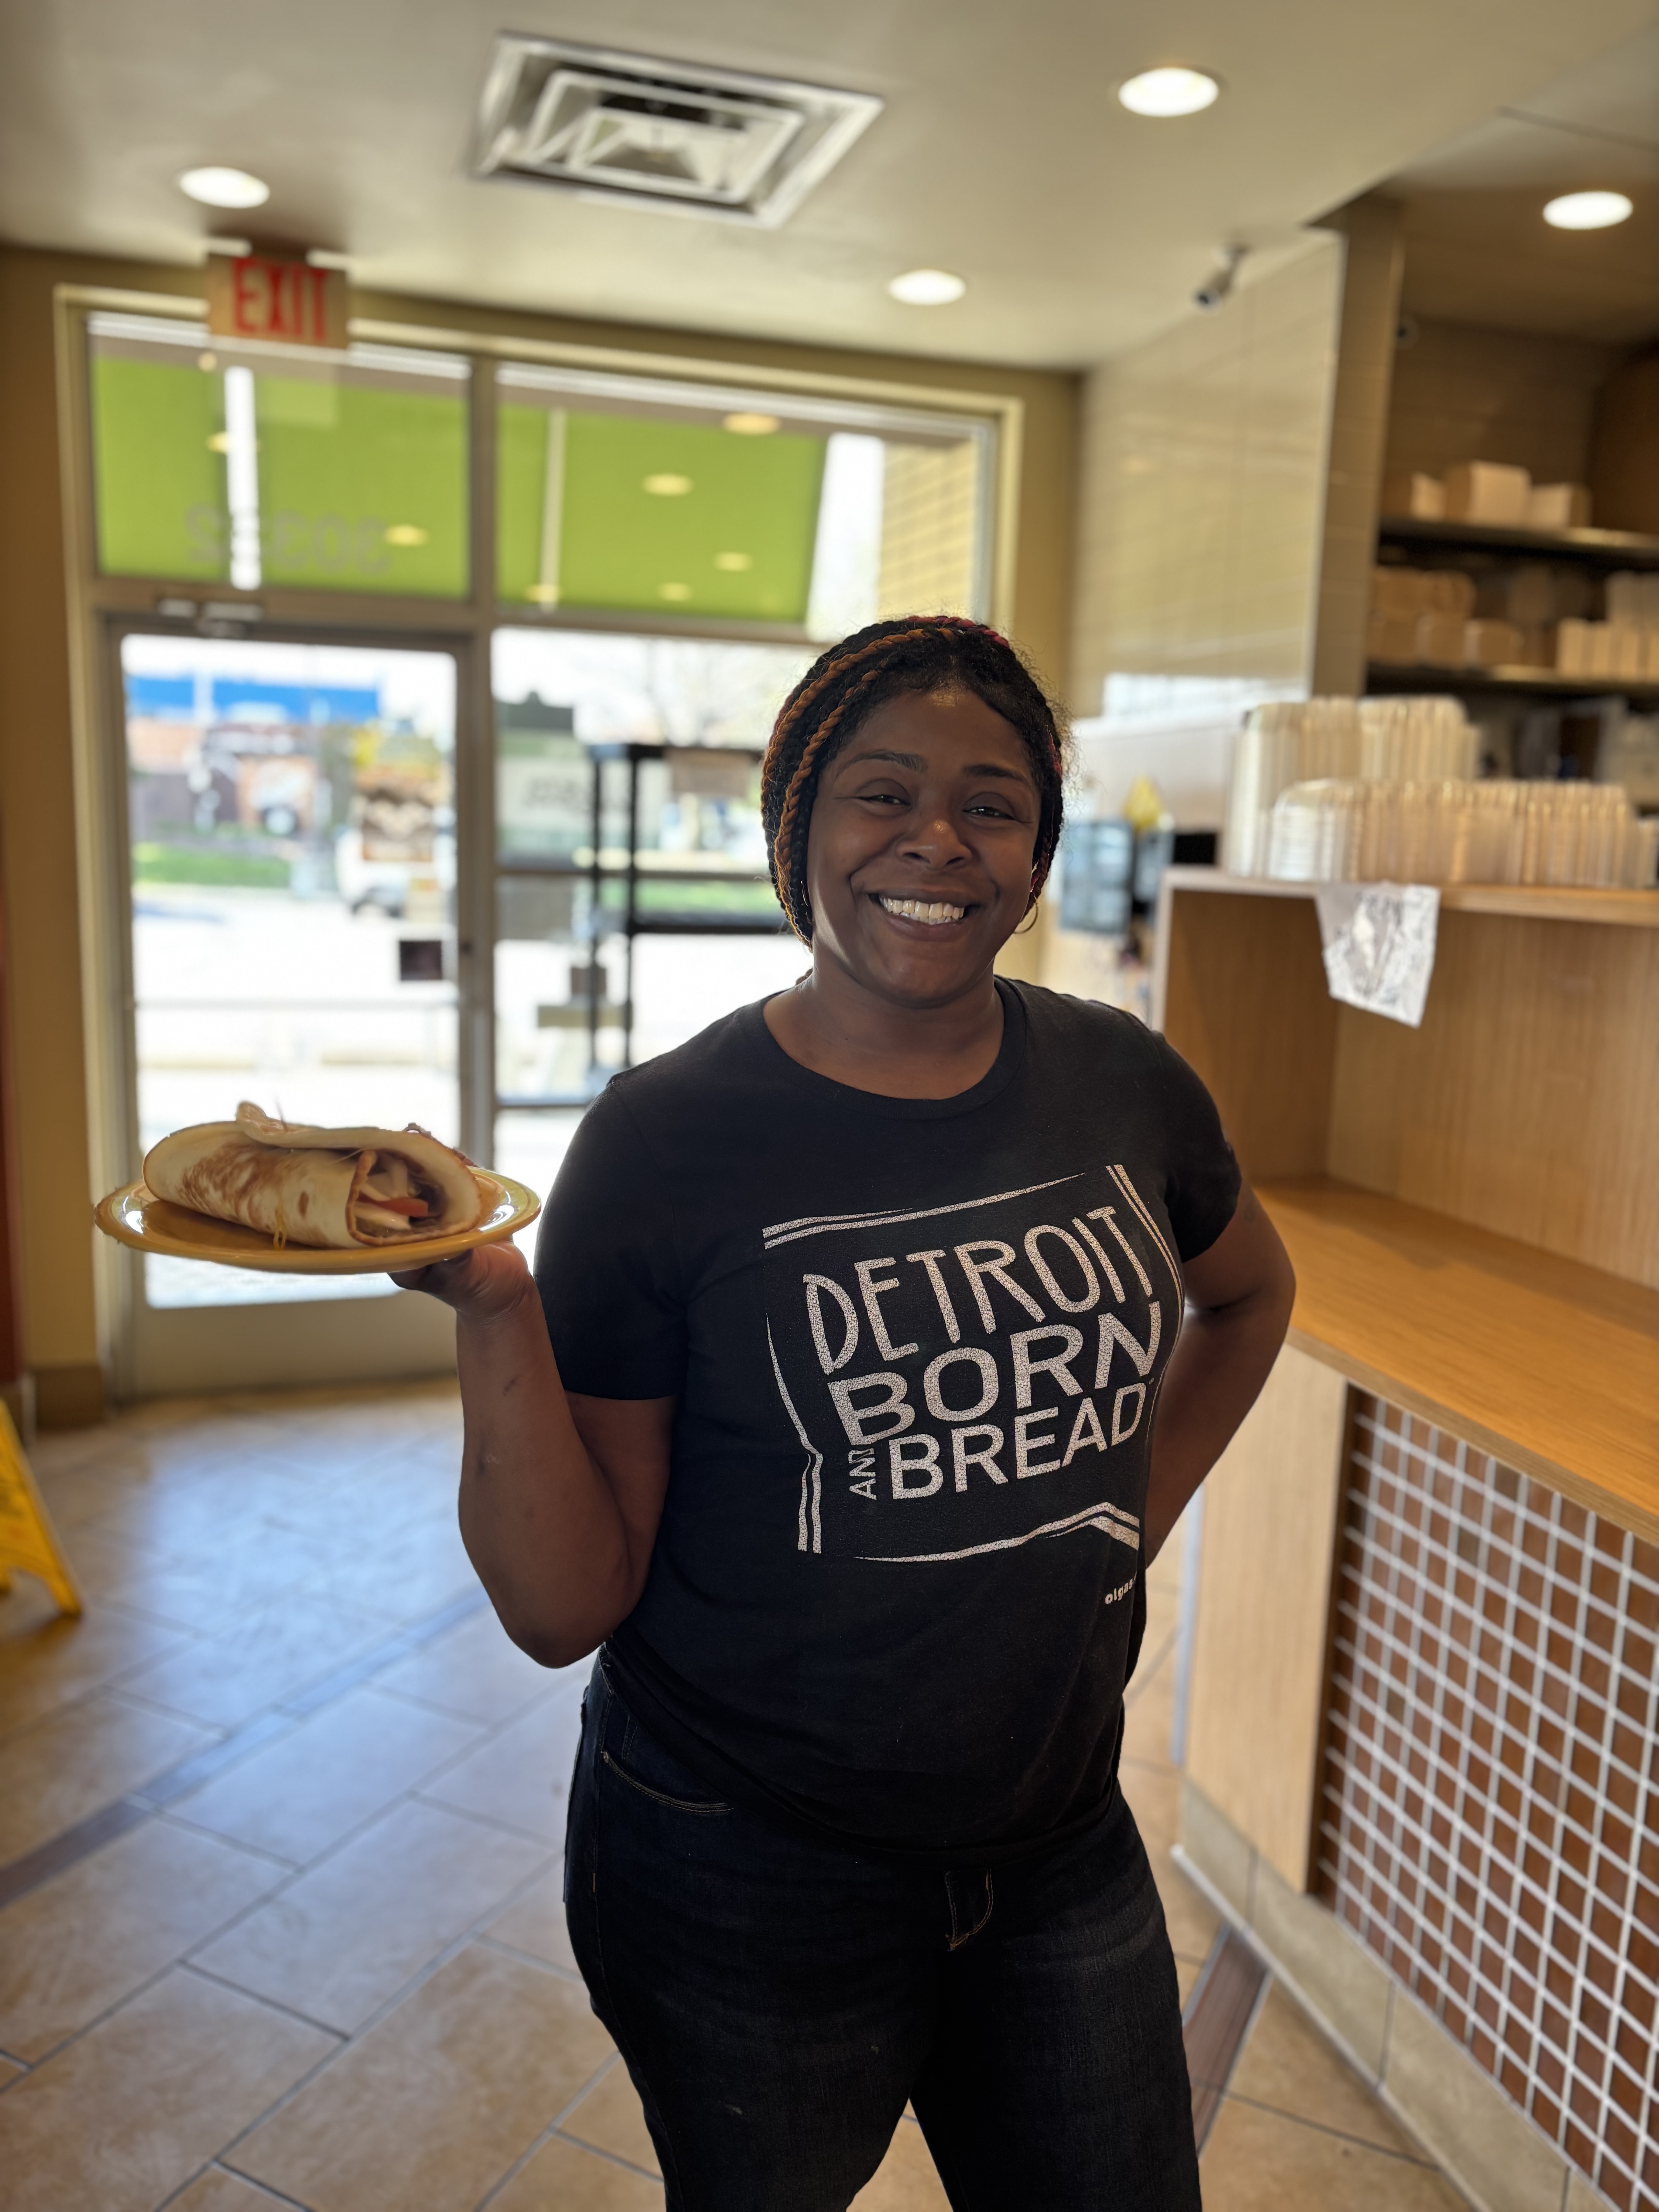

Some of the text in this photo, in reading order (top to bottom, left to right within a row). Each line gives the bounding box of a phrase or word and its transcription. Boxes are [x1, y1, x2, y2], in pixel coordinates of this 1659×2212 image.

[232, 257, 334, 343] EXIT
[803, 1206, 1152, 1375] DETROIT
[827, 1301, 1161, 1445] BORN
[848, 1383, 1146, 1500] AND BREAD
